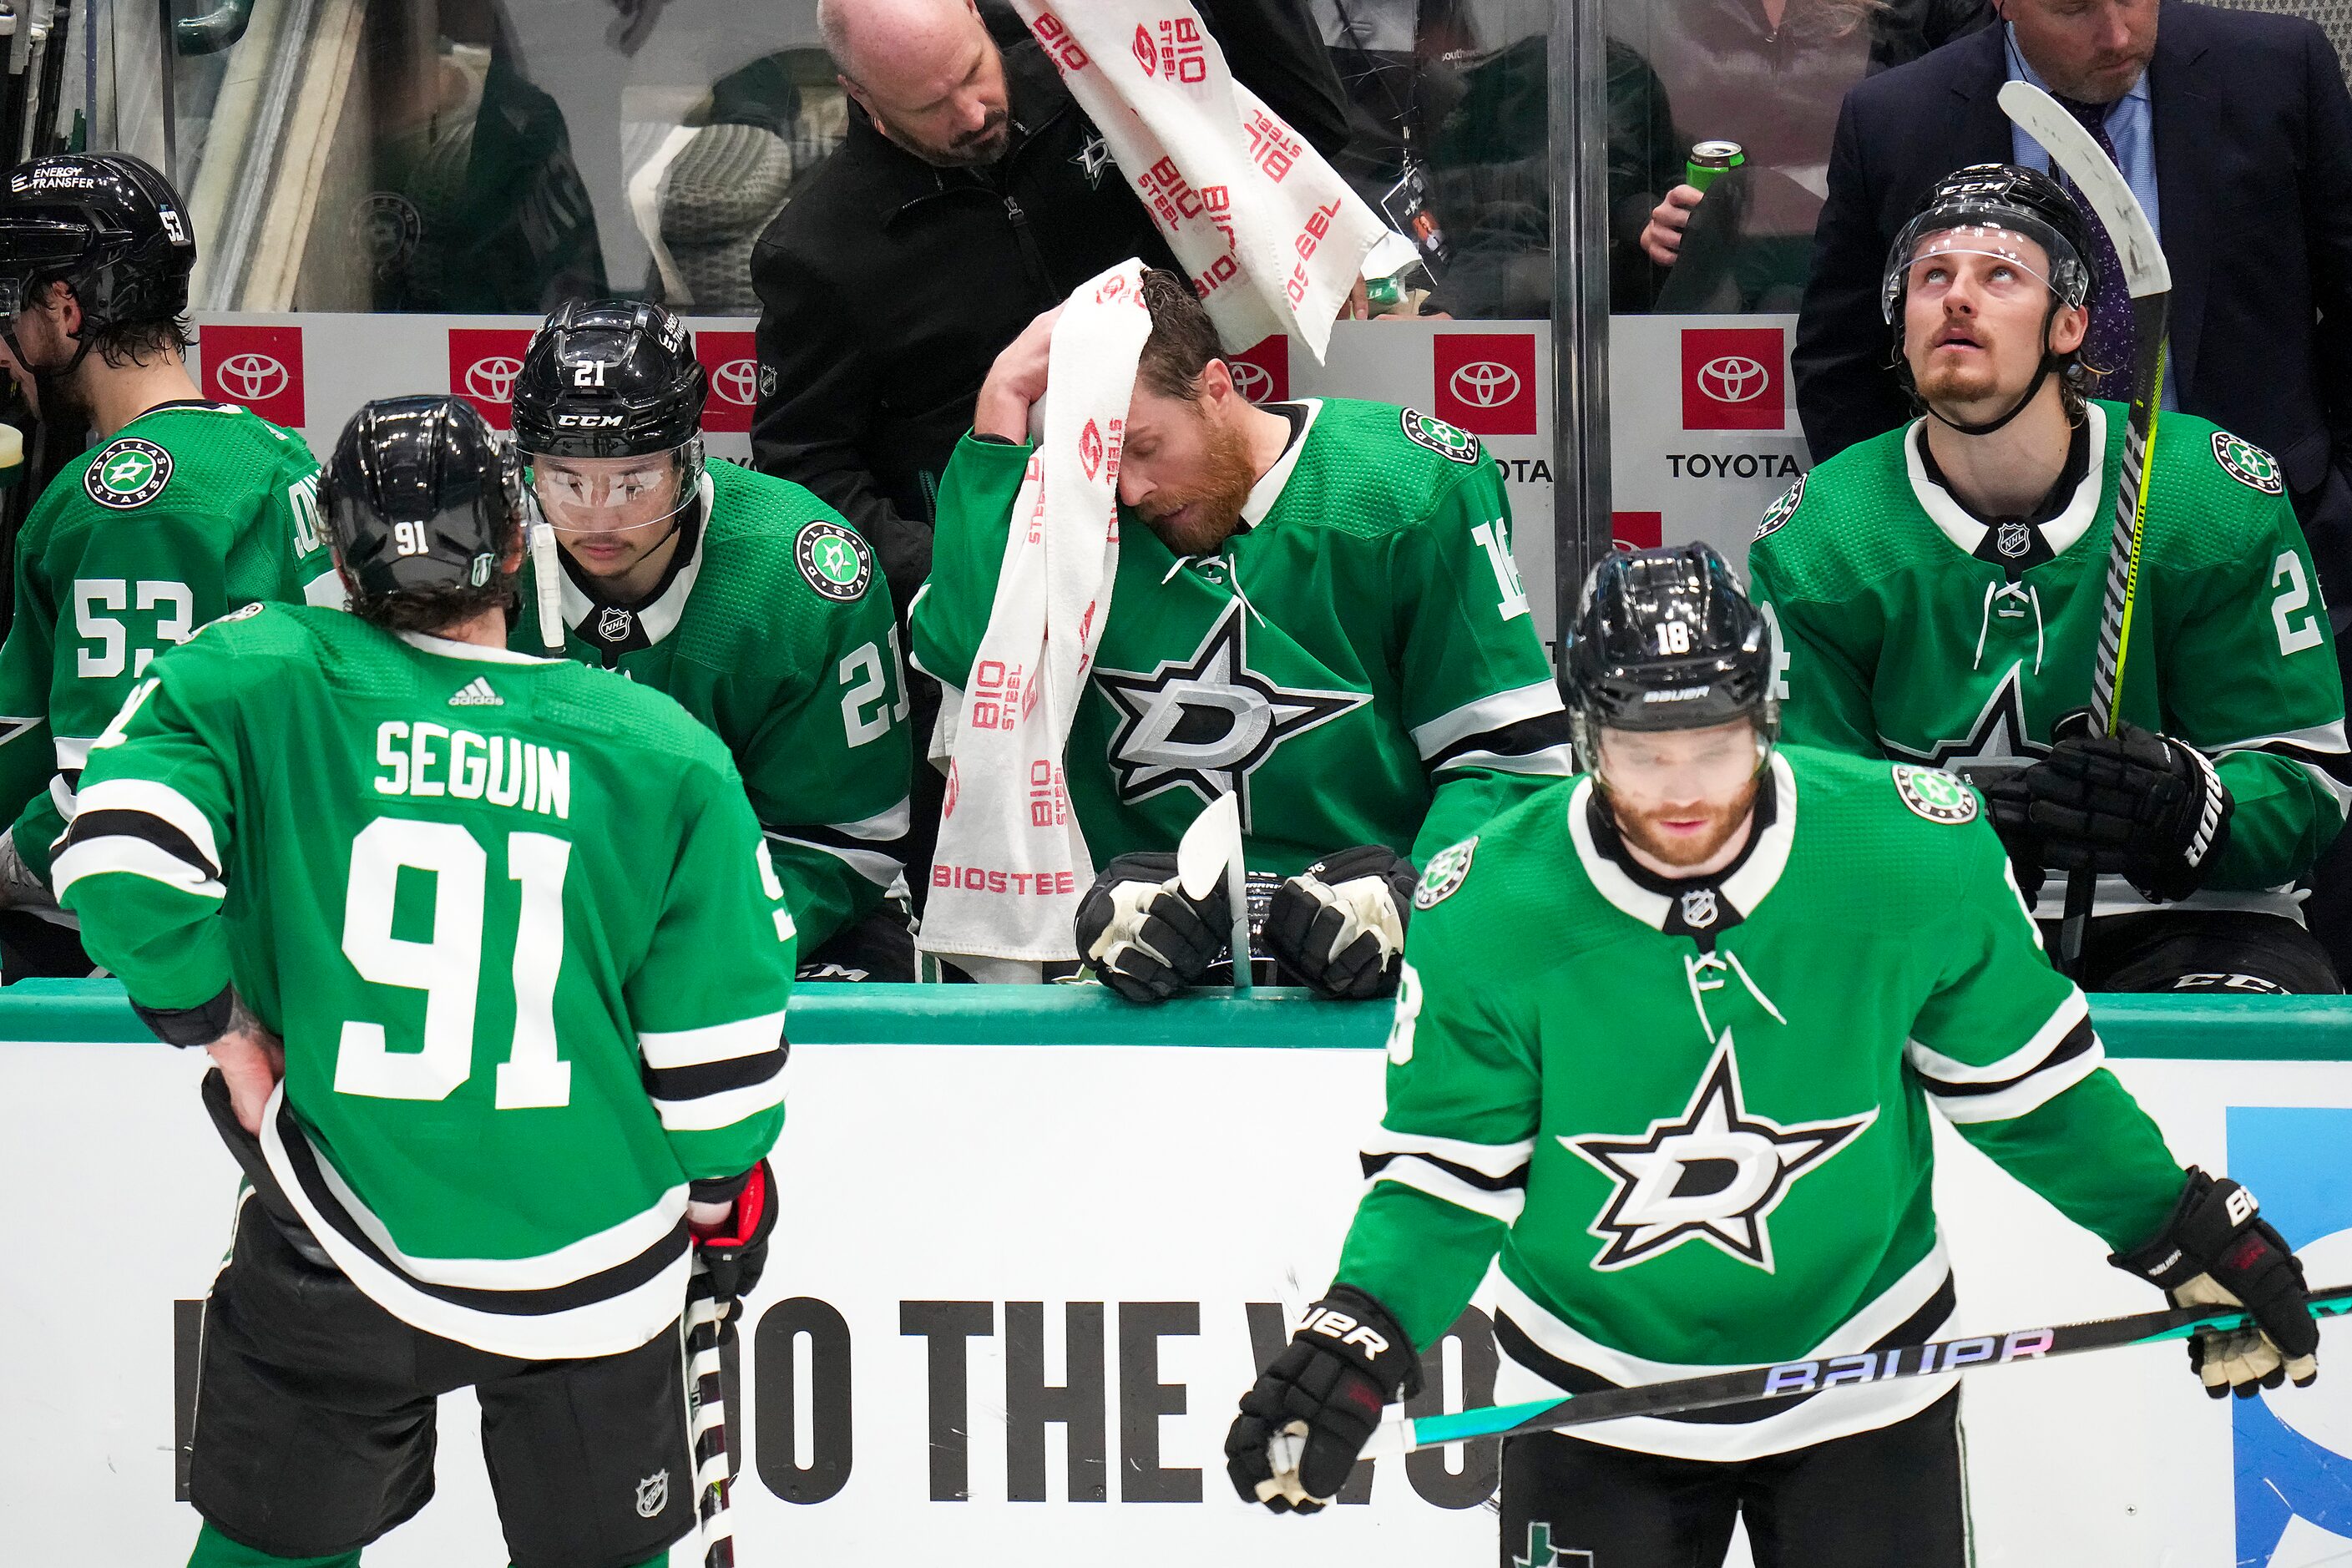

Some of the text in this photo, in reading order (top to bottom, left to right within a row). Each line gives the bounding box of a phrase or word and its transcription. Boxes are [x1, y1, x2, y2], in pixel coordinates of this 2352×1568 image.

[1033, 12, 1089, 70] BIO
[1159, 20, 1176, 82] STEEL
[1175, 18, 1206, 83] BIO
[1252, 109, 1303, 159] STEEL
[32, 177, 94, 189] TRANSFER
[33, 166, 83, 178] ENERGY
[1940, 181, 2006, 196] CCM
[159, 210, 185, 242] 53
[1138, 173, 1179, 231] STEEL
[574, 360, 604, 387] 21
[558, 415, 624, 427] CCM
[94, 443, 167, 503] DALLAS STARS
[1106, 417, 1122, 486] STEEL
[1666, 453, 1802, 478] TOYOTA
[394, 519, 430, 556] 91
[802, 526, 868, 595] DALLAS STARS
[2005, 532, 2024, 550] NHL
[73, 579, 194, 679] 53
[604, 619, 625, 633] NHL
[2272, 549, 2327, 657] 2
[1655, 620, 1691, 655] 18
[448, 695, 504, 706] adidas
[839, 621, 910, 749] 21
[972, 660, 1006, 730] BIO
[1001, 664, 1023, 732] STEEL
[374, 721, 571, 820] SEGUIN
[1029, 759, 1053, 827] BIO
[333, 815, 573, 1110] 91
[899, 1301, 1203, 1504] THE
